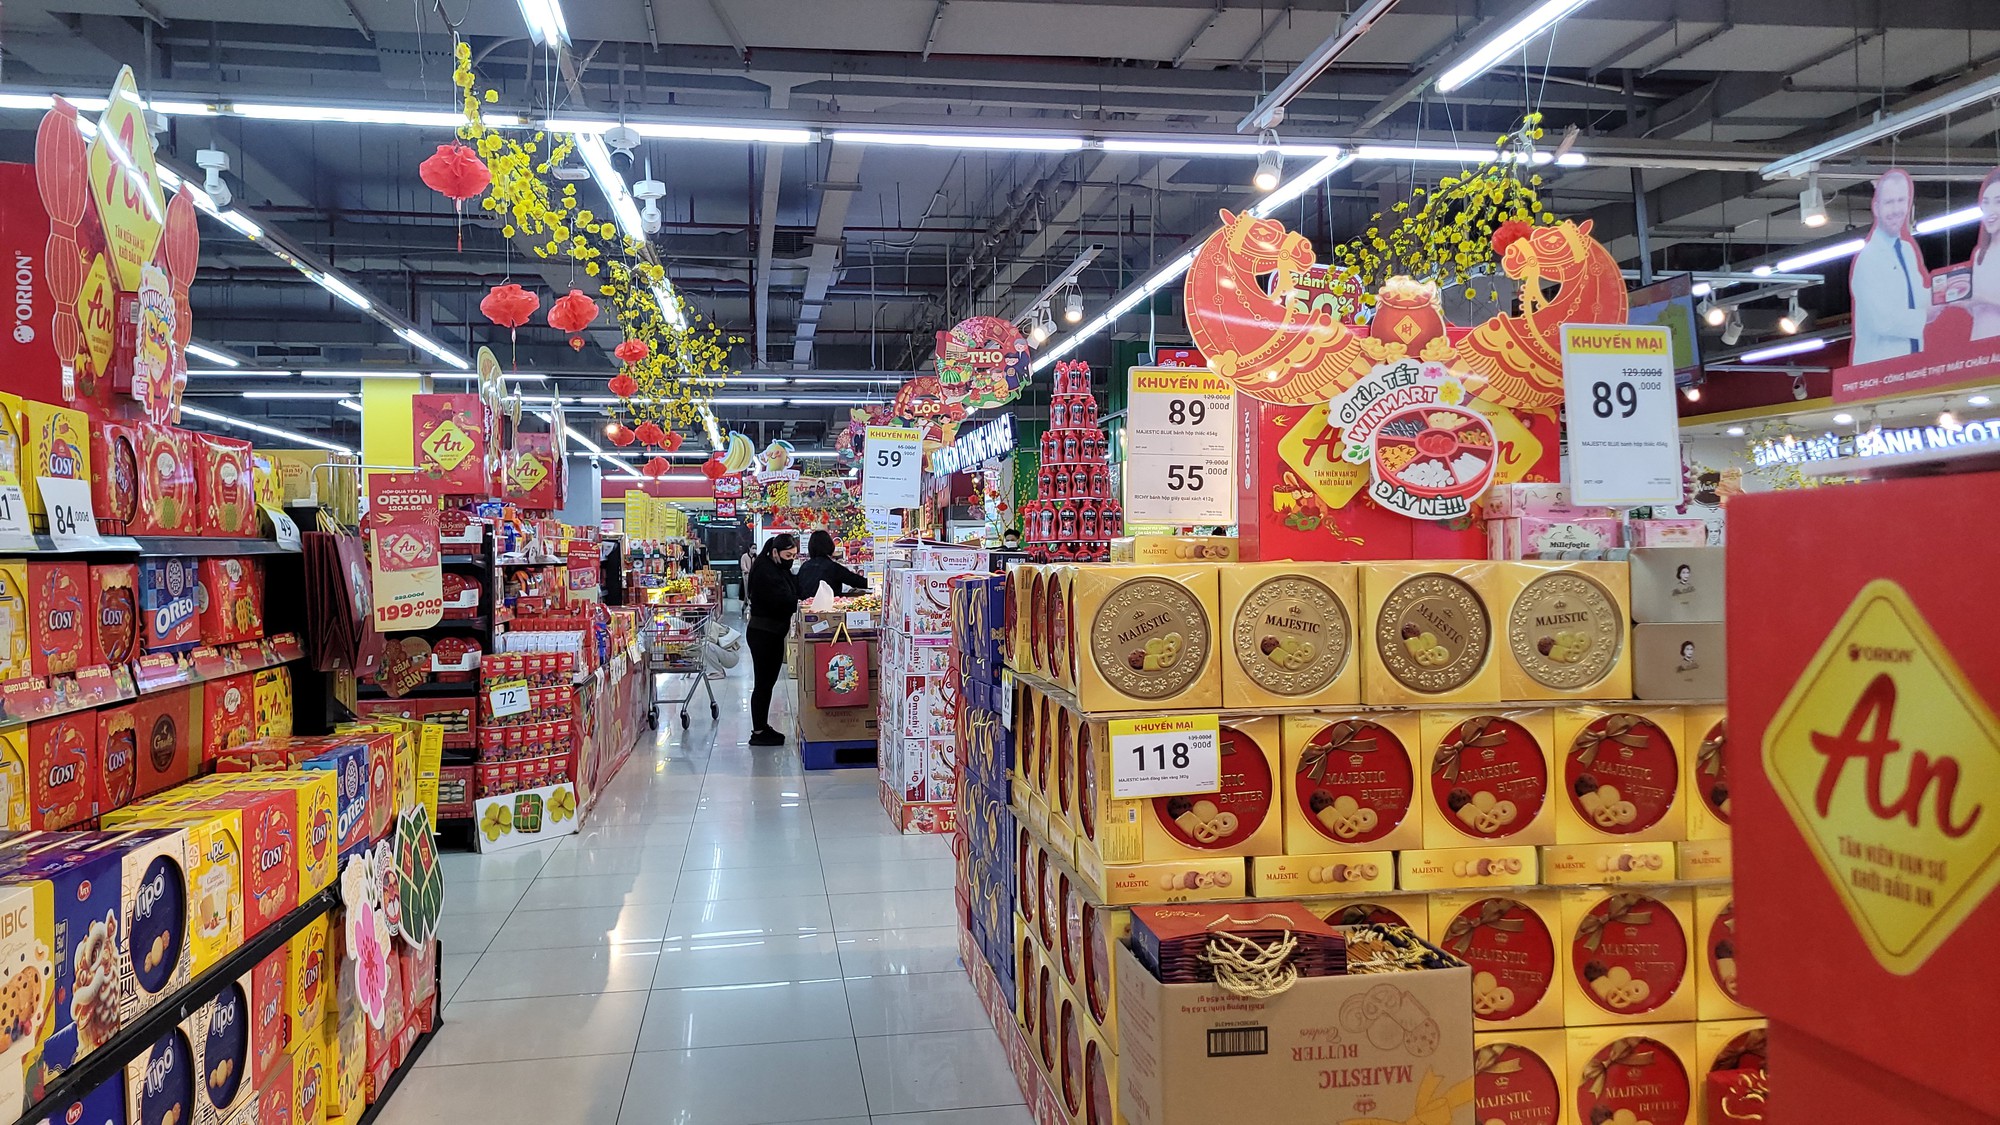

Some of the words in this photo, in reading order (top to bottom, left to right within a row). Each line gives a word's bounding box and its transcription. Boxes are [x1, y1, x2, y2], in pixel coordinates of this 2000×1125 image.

[16, 256, 33, 320] ORION
[88, 282, 113, 334] An
[1572, 333, 1631, 349] KHUYẾN
[1637, 338, 1663, 352] MẠI
[969, 351, 1003, 366] THỌ
[1138, 374, 1198, 390] KHUYẾN
[1353, 382, 1385, 410] KÌA
[1382, 363, 1419, 390] TẾT
[914, 401, 940, 416] LỘC
[1592, 381, 1637, 418] 89
[1169, 400, 1206, 425] 89
[1349, 386, 1438, 443] WINMART
[433, 432, 464, 453] An
[870, 430, 902, 439] KHUYẾN
[904, 433, 919, 441] MẠI
[1856, 424, 1924, 457] BÁNH
[1302, 425, 1346, 467] A
[50, 453, 74, 475] COSY
[877, 450, 902, 467] 59
[517, 461, 540, 477] An
[1168, 465, 1204, 490] 55
[377, 494, 432, 505] ORION
[1376, 480, 1417, 511] ĐÂY
[1419, 493, 1466, 516] NÈ!!!
[55, 505, 76, 534] 84
[279, 517, 292, 537] 49
[399, 541, 417, 553] An
[1550, 541, 1590, 549] Millefoglie
[49, 610, 74, 631] COSY
[102, 608, 125, 627] COSY
[156, 597, 194, 634] OREO
[377, 603, 413, 622] 199
[1536, 611, 1589, 628] MAJESTIC
[1118, 612, 1172, 645] MAJESTIC
[1265, 614, 1321, 634] MAJESTIC
[1416, 603, 1464, 645] MAJESTIC
[270, 691, 284, 719] An
[499, 691, 517, 705] 72
[1134, 720, 1173, 732] KHUYẾN
[1176, 721, 1193, 731] MẠI
[1191, 741, 1211, 750] .900đ
[1810, 672, 1983, 838] An
[108, 750, 127, 772] COSY
[1132, 742, 1190, 771] 118
[49, 763, 77, 788] COSY
[1326, 769, 1386, 785] MAJESTIC
[1461, 760, 1521, 783] MAJESTIC
[1596, 760, 1653, 780] MAJESTIC
[1360, 788, 1403, 801] BUTTER
[1497, 776, 1540, 793] BUTTER
[1626, 783, 1665, 798] BUTTER
[1220, 790, 1264, 802] BUTTER
[338, 796, 365, 841] OREO
[312, 819, 328, 846] COSY
[261, 845, 284, 872] COSY
[1555, 862, 1586, 871] MAJESTIC
[1691, 856, 1722, 865] MAJESTIC
[1266, 872, 1299, 881] MAJESTIC
[1412, 866, 1444, 874] MAJESTIC
[1115, 880, 1149, 889] MAJESTIC
[136, 872, 165, 922] Tipo
[1471, 947, 1529, 965] MAJESTIC
[1600, 943, 1661, 957] MAJESTIC
[305, 965, 319, 988] COSY
[1501, 968, 1544, 983] BUTTER
[211, 1000, 236, 1038] Tipo
[264, 998, 278, 1028] COSY
[1290, 1043, 1358, 1062] BUTTER
[144, 1046, 174, 1098] Tipo
[1318, 1064, 1413, 1090] MAJESTIC
[302, 1082, 317, 1109] COSY
[1475, 1090, 1533, 1109] MAJESTIC
[1606, 1083, 1663, 1098] MAJESTIC
[1509, 1105, 1552, 1120] BUTTER
